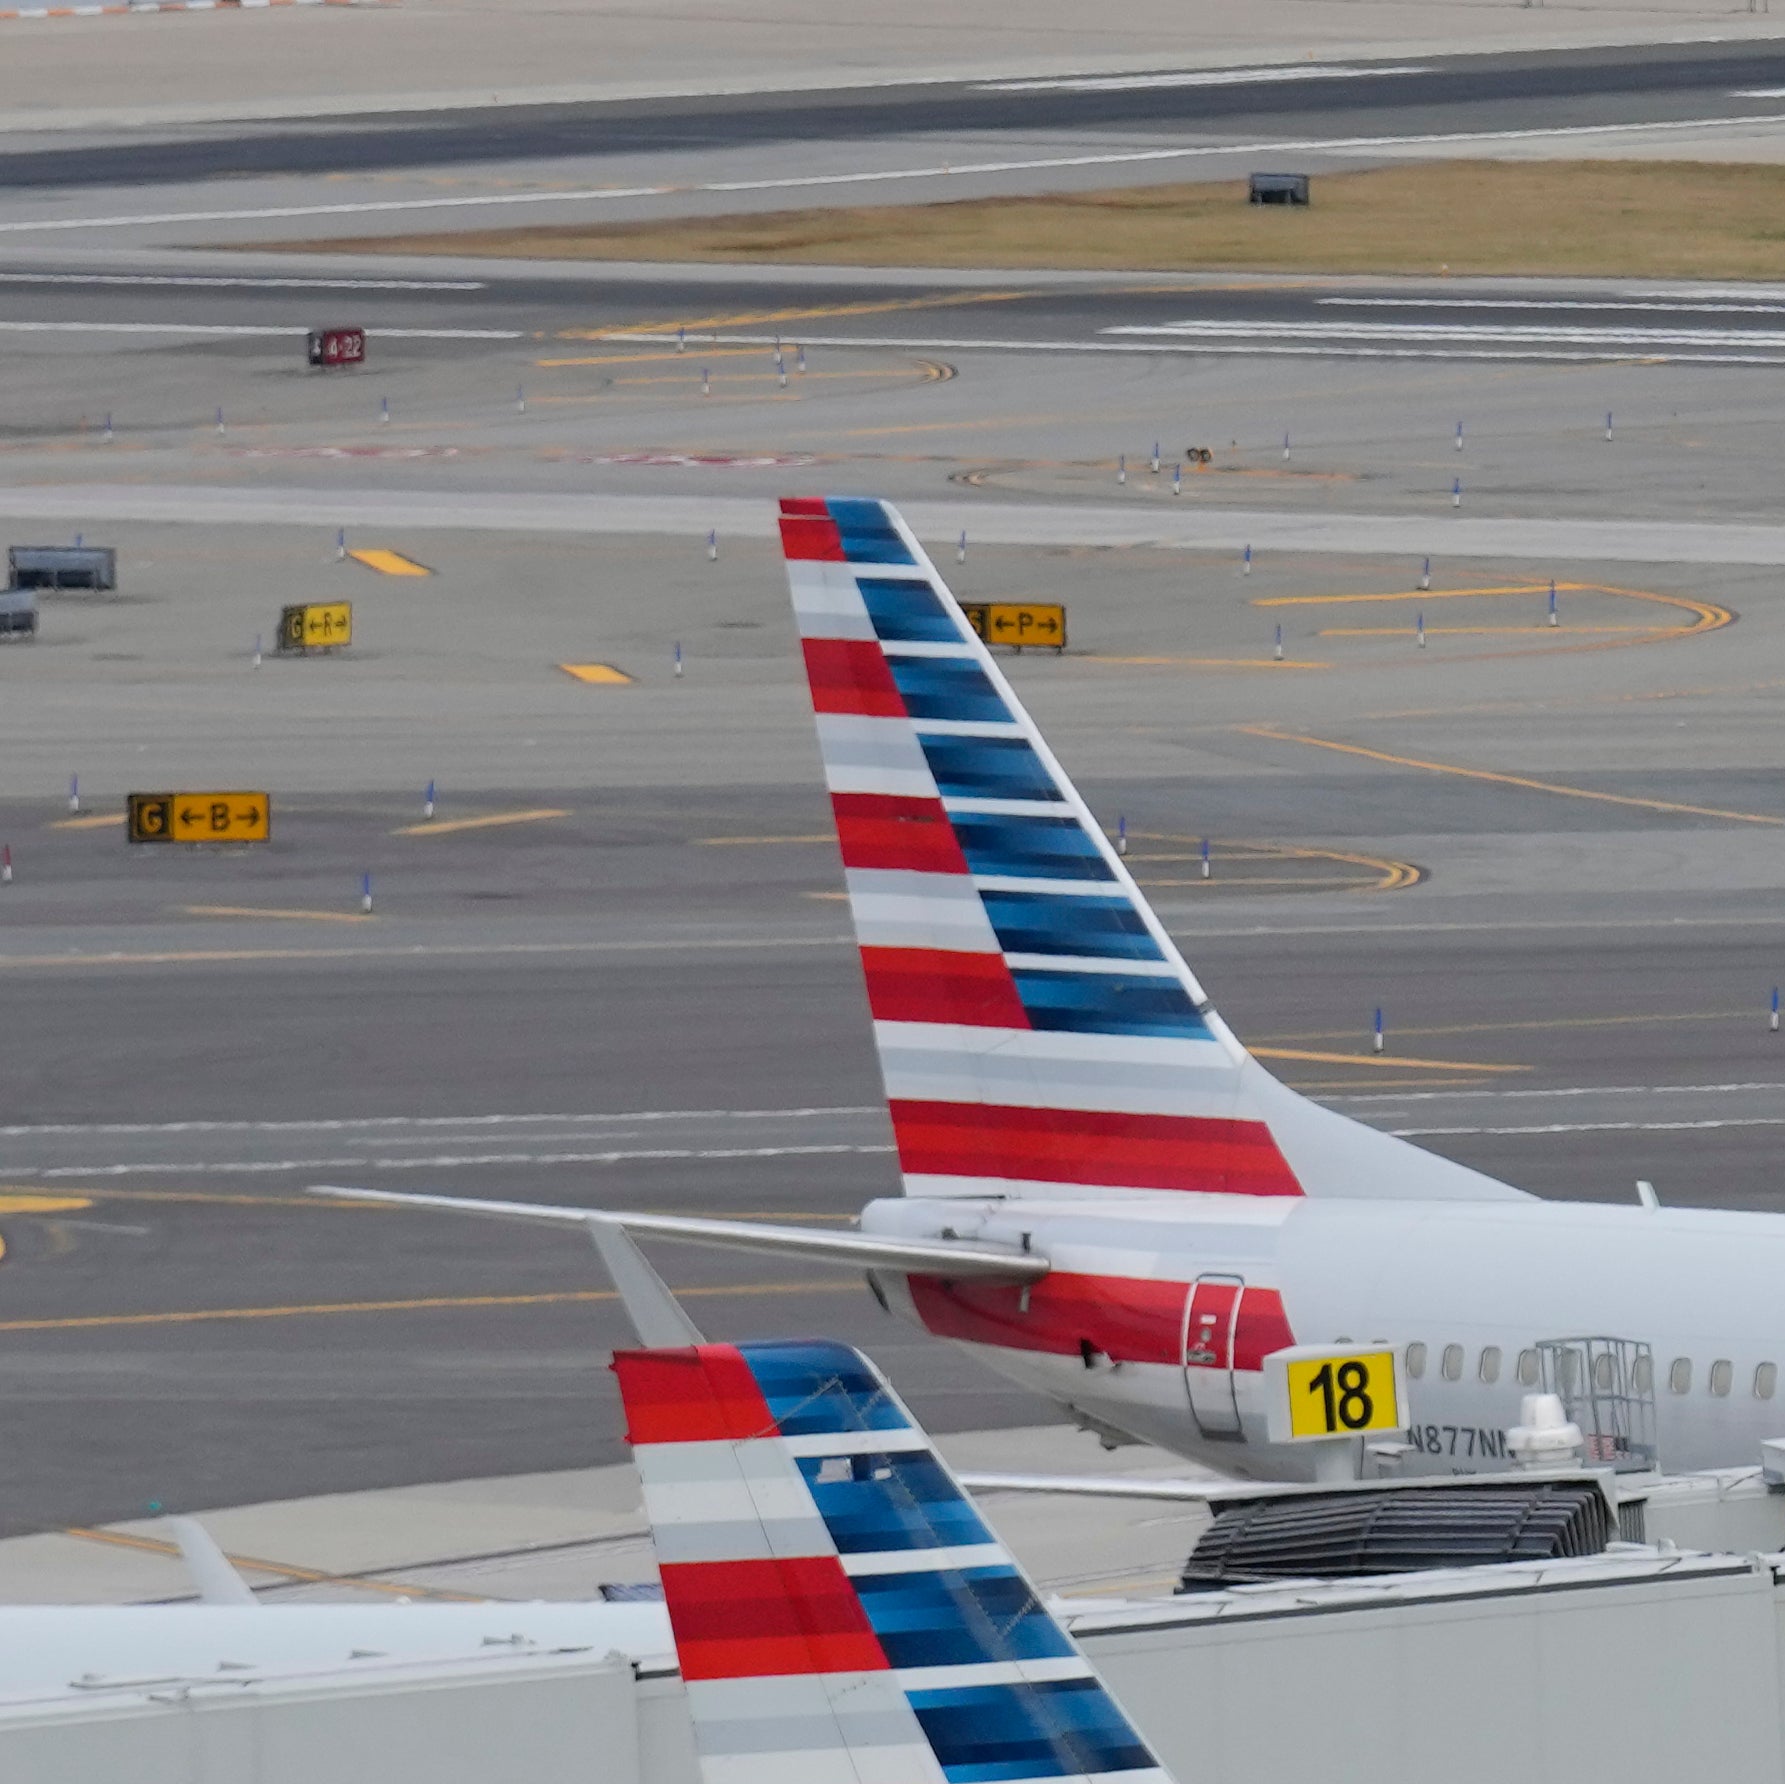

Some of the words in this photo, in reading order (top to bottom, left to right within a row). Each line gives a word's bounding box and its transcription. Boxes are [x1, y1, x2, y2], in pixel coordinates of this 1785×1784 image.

[1018, 613, 1031, 635] P
[143, 803, 171, 838] G
[210, 804, 232, 832] B
[1308, 1360, 1373, 1434] 18
